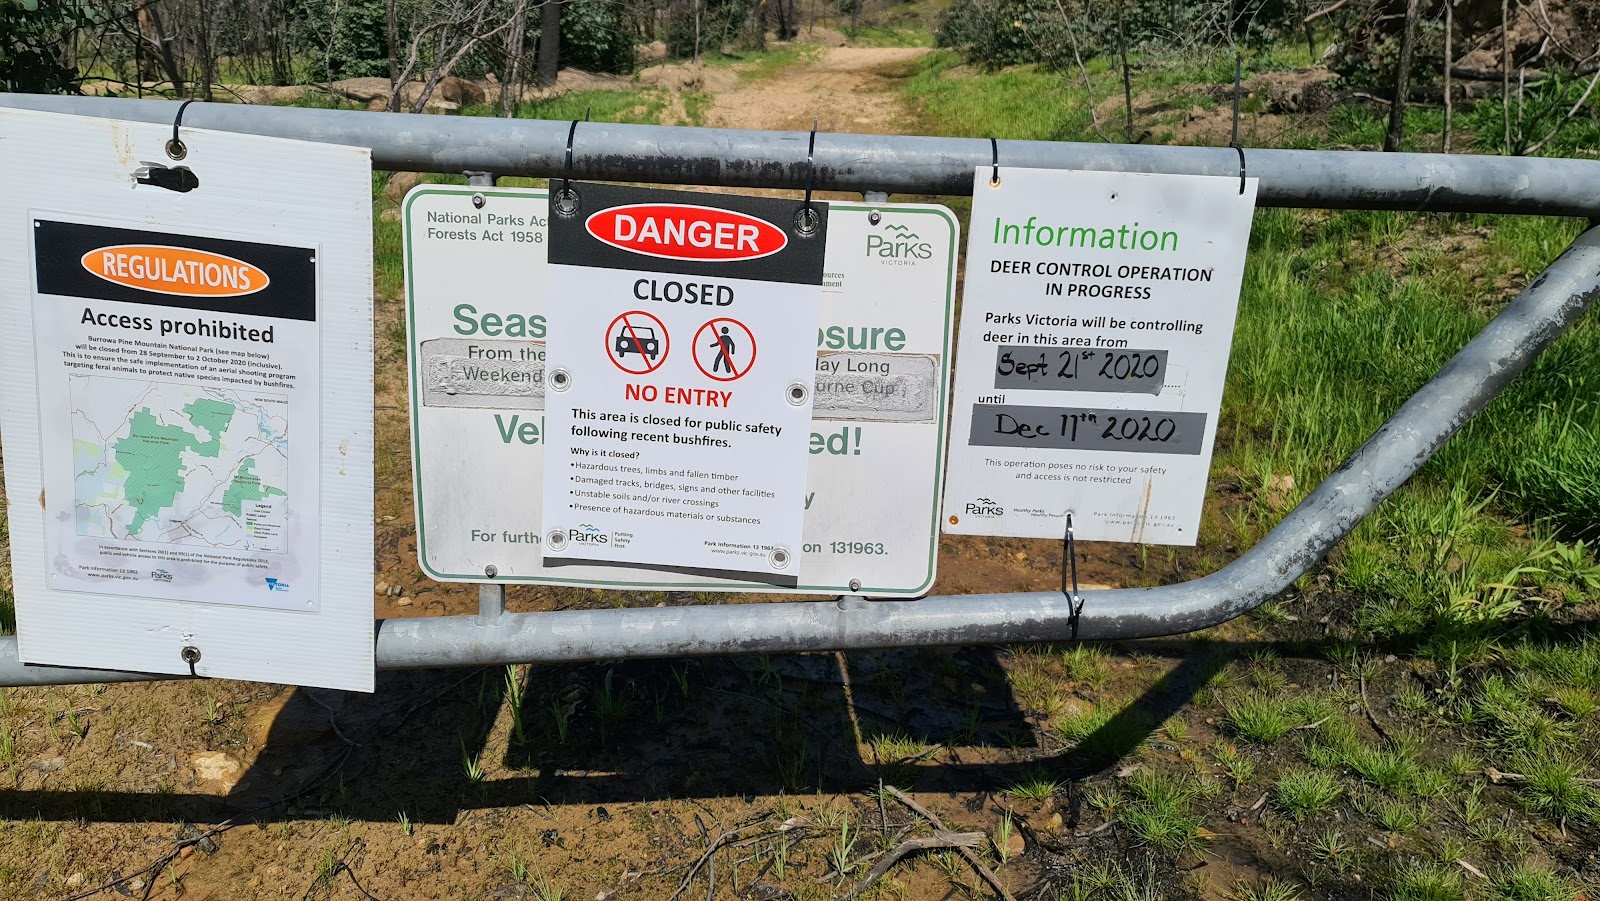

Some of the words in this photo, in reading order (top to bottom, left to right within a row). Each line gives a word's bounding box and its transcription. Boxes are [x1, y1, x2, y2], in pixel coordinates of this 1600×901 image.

[427, 211, 482, 224] National
[487, 214, 524, 226] Parks
[530, 216, 549, 227] Ac
[428, 228, 477, 240] Forests
[482, 230, 504, 242] Act
[510, 231, 543, 243] 1958
[614, 214, 760, 252] DANGER
[992, 216, 1179, 252] Information
[866, 234, 932, 259] Parks
[102, 252, 250, 290] REGULATIONS
[990, 260, 1030, 274] DEER
[1036, 262, 1111, 278] CONTROL
[1117, 265, 1212, 282] OPERATION
[633, 278, 734, 307] CLOSED
[1045, 283, 1061, 296] IN
[1068, 284, 1150, 300] PROGRESS
[81, 307, 153, 332] Access
[160, 318, 275, 344] prohibited
[453, 303, 546, 338] Seas
[985, 312, 1021, 324] Parks
[1025, 314, 1077, 327] Victoria
[1081, 316, 1105, 328] will
[1109, 317, 1126, 328] be
[1129, 318, 1204, 334] controlling
[87, 335, 116, 344] Burrowa
[134, 339, 167, 349] Mountain
[168, 343, 197, 352] National
[215, 347, 229, 355] (see
[246, 350, 269, 360] below)
[817, 326, 906, 351] sure
[982, 330, 1014, 343] deer
[1017, 332, 1029, 344] in
[1034, 333, 1057, 345] this
[1062, 337, 1091, 346] area
[1095, 336, 1127, 348] from
[148, 350, 186, 360] September
[201, 355, 228, 364] October
[247, 360, 282, 370] (inclusive).
[468, 346, 513, 361] From
[520, 348, 546, 362] the
[63, 360, 94, 371] targeting
[111, 365, 138, 373] animals
[221, 375, 252, 384] impacted
[253, 378, 262, 387] by
[263, 379, 295, 389] bushfires.
[144, 359, 198, 370] implementation
[238, 368, 267, 379] shooting
[462, 366, 543, 383] Weekend
[847, 358, 890, 376] Long
[997, 350, 1049, 381] Sept
[1057, 350, 1096, 380] 21st
[1098, 352, 1159, 380] 2020
[625, 384, 658, 402] NO
[665, 386, 733, 408] ENTRY
[862, 380, 895, 398] Cup
[978, 394, 1006, 404] until
[571, 408, 596, 420] This
[599, 413, 626, 422] area
[629, 413, 639, 423] is
[642, 414, 680, 426] closed
[684, 417, 702, 428] for
[705, 419, 742, 432] public
[745, 422, 781, 437] safety
[994, 413, 1050, 439] Dec
[1101, 416, 1176, 443] 2020
[571, 425, 627, 443] following
[630, 432, 670, 443] recent
[673, 433, 731, 448] bushfires.
[809, 426, 862, 456] ed!
[570, 447, 590, 458] Why
[608, 450, 639, 459] closed?
[575, 461, 618, 472] Hazardous
[620, 465, 643, 476] trees,
[645, 466, 667, 476] limbs
[668, 469, 684, 477] and
[686, 469, 709, 479] fallen
[711, 471, 738, 481] timber
[984, 458, 1001, 466] This
[1003, 460, 1045, 469] operation
[1048, 463, 1072, 471] poses
[1088, 463, 1103, 471] risk
[1106, 463, 1115, 472] to
[1118, 466, 1137, 474] your
[1140, 465, 1166, 476] safety
[575, 475, 613, 487] Damaged
[615, 478, 641, 490] tracks,
[644, 480, 676, 492] bridges,
[678, 483, 698, 494] signs
[700, 485, 715, 493] and
[717, 486, 740, 495] other
[742, 488, 775, 498] facilities
[1015, 472, 1032, 480] and
[1063, 473, 1070, 481] is
[1072, 474, 1087, 482] not
[1089, 475, 1131, 484] restricted
[574, 489, 610, 499] Unstable
[612, 492, 630, 500] soils
[632, 493, 660, 504] and/or
[661, 495, 681, 504] river
[682, 498, 719, 508] crossings
[965, 502, 1004, 516] Parks
[574, 502, 610, 513] Presence
[612, 505, 621, 513] of
[623, 506, 664, 517] hazardous
[666, 510, 703, 520] materials
[716, 514, 760, 524] substances
[471, 529, 496, 542] For
[502, 531, 542, 544] furth
[569, 529, 608, 544] Parks
[802, 543, 822, 553] on
[830, 542, 888, 555] 131963.
